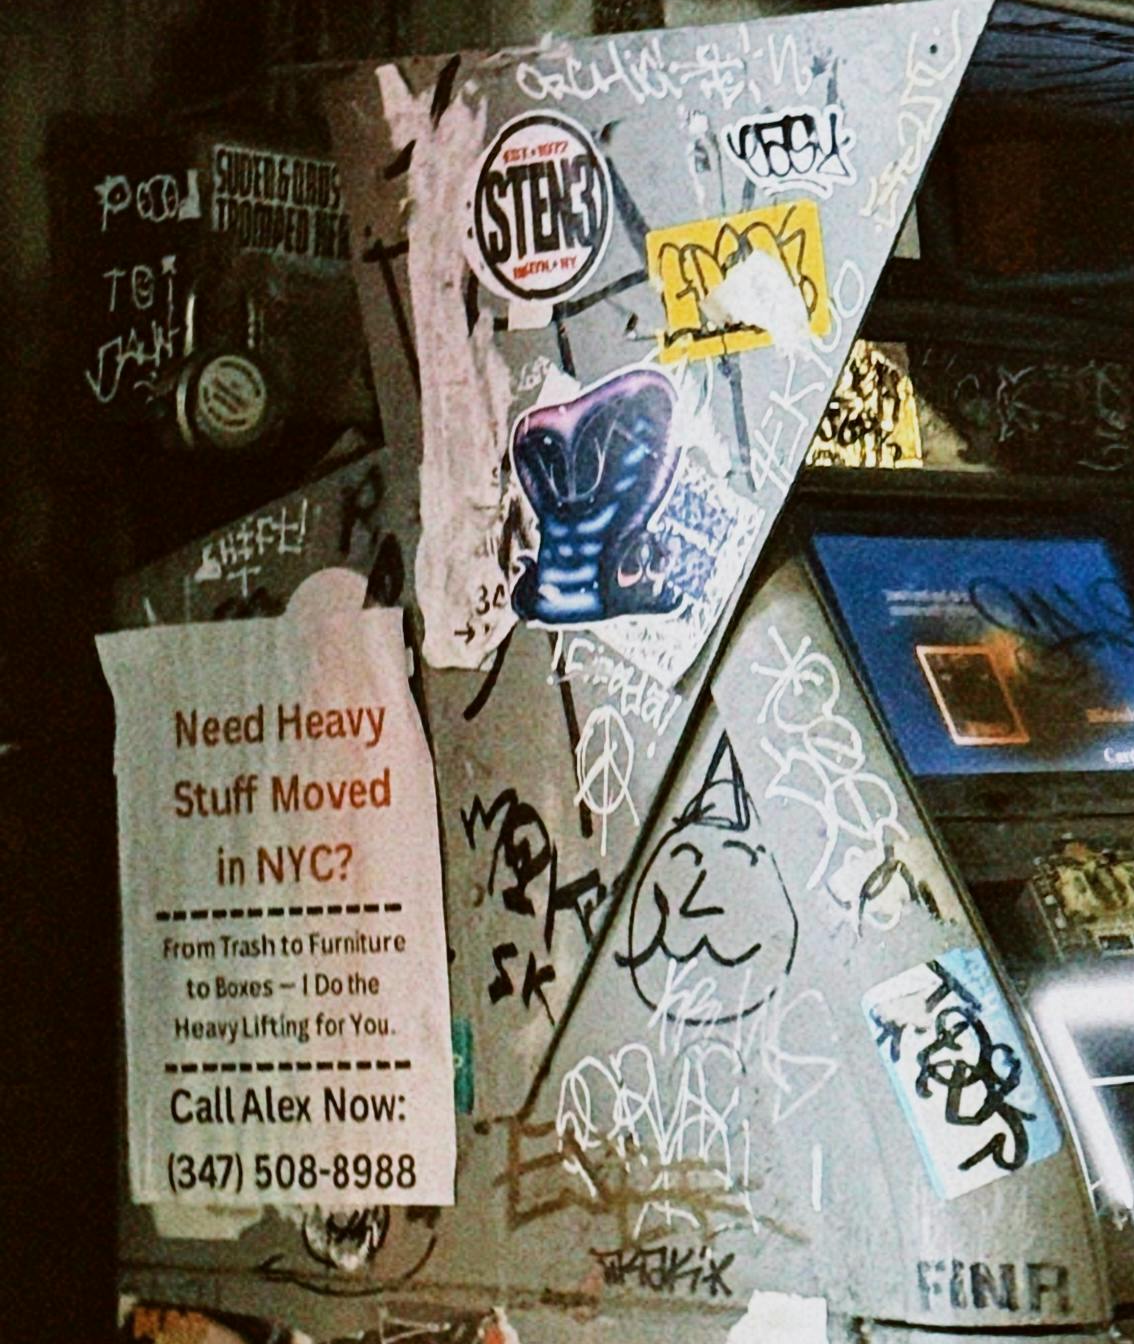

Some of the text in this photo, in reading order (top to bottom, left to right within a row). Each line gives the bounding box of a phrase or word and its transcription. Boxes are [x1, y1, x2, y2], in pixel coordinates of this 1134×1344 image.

[485, 153, 604, 264] STEN3
[175, 703, 384, 748] Need Heavy
[174, 769, 390, 818] Stuff Moved
[218, 844, 352, 885] in NYC?
[163, 933, 405, 959] From Trash to Furniture
[187, 979, 210, 999] to
[215, 976, 273, 999] Boxes
[303, 974, 307, 995] I
[315, 973, 343, 996] Do
[348, 973, 379, 995] the
[175, 1012, 397, 1044] Heavy Lifting for You.
[170, 1086, 404, 1124] Call Alex Now:
[168, 1153, 415, 1193] (347) 508-8988
